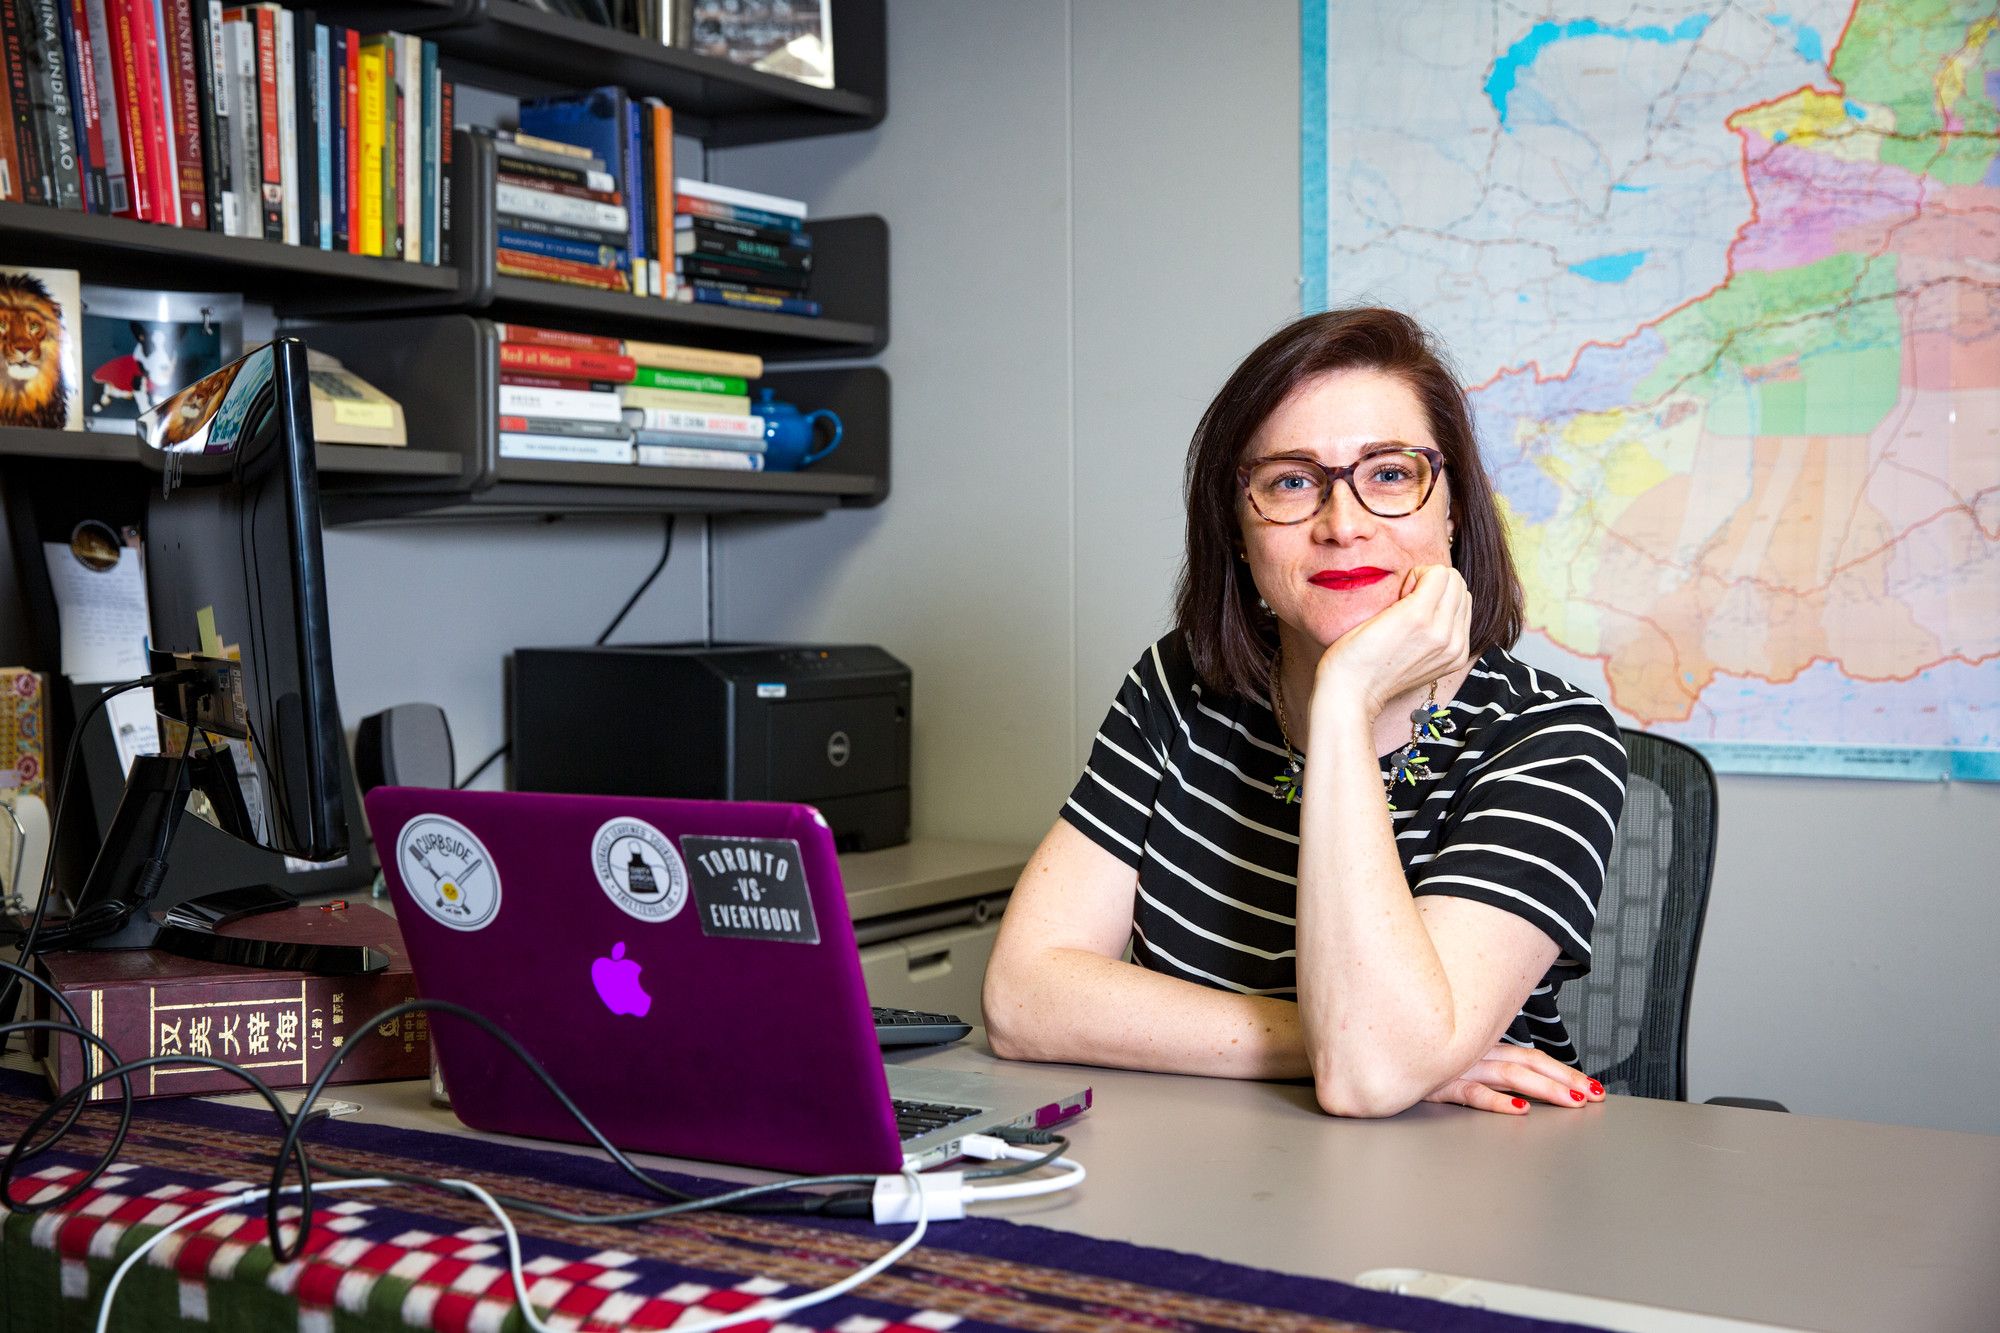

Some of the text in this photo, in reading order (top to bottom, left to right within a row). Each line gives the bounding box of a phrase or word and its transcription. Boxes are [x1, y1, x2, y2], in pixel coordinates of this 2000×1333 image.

[47, 50, 68, 116] UNDER
[263, 49, 276, 84] PARTY
[183, 78, 200, 158] DRIVING
[57, 124, 74, 171] MAO
[501, 346, 571, 369] Red at Heart
[415, 833, 473, 865] CURBSIDE
[697, 847, 789, 882] TORONTO
[710, 903, 802, 933] EVERYBODY
[160, 1010, 298, 1057] 汉英大辞海
